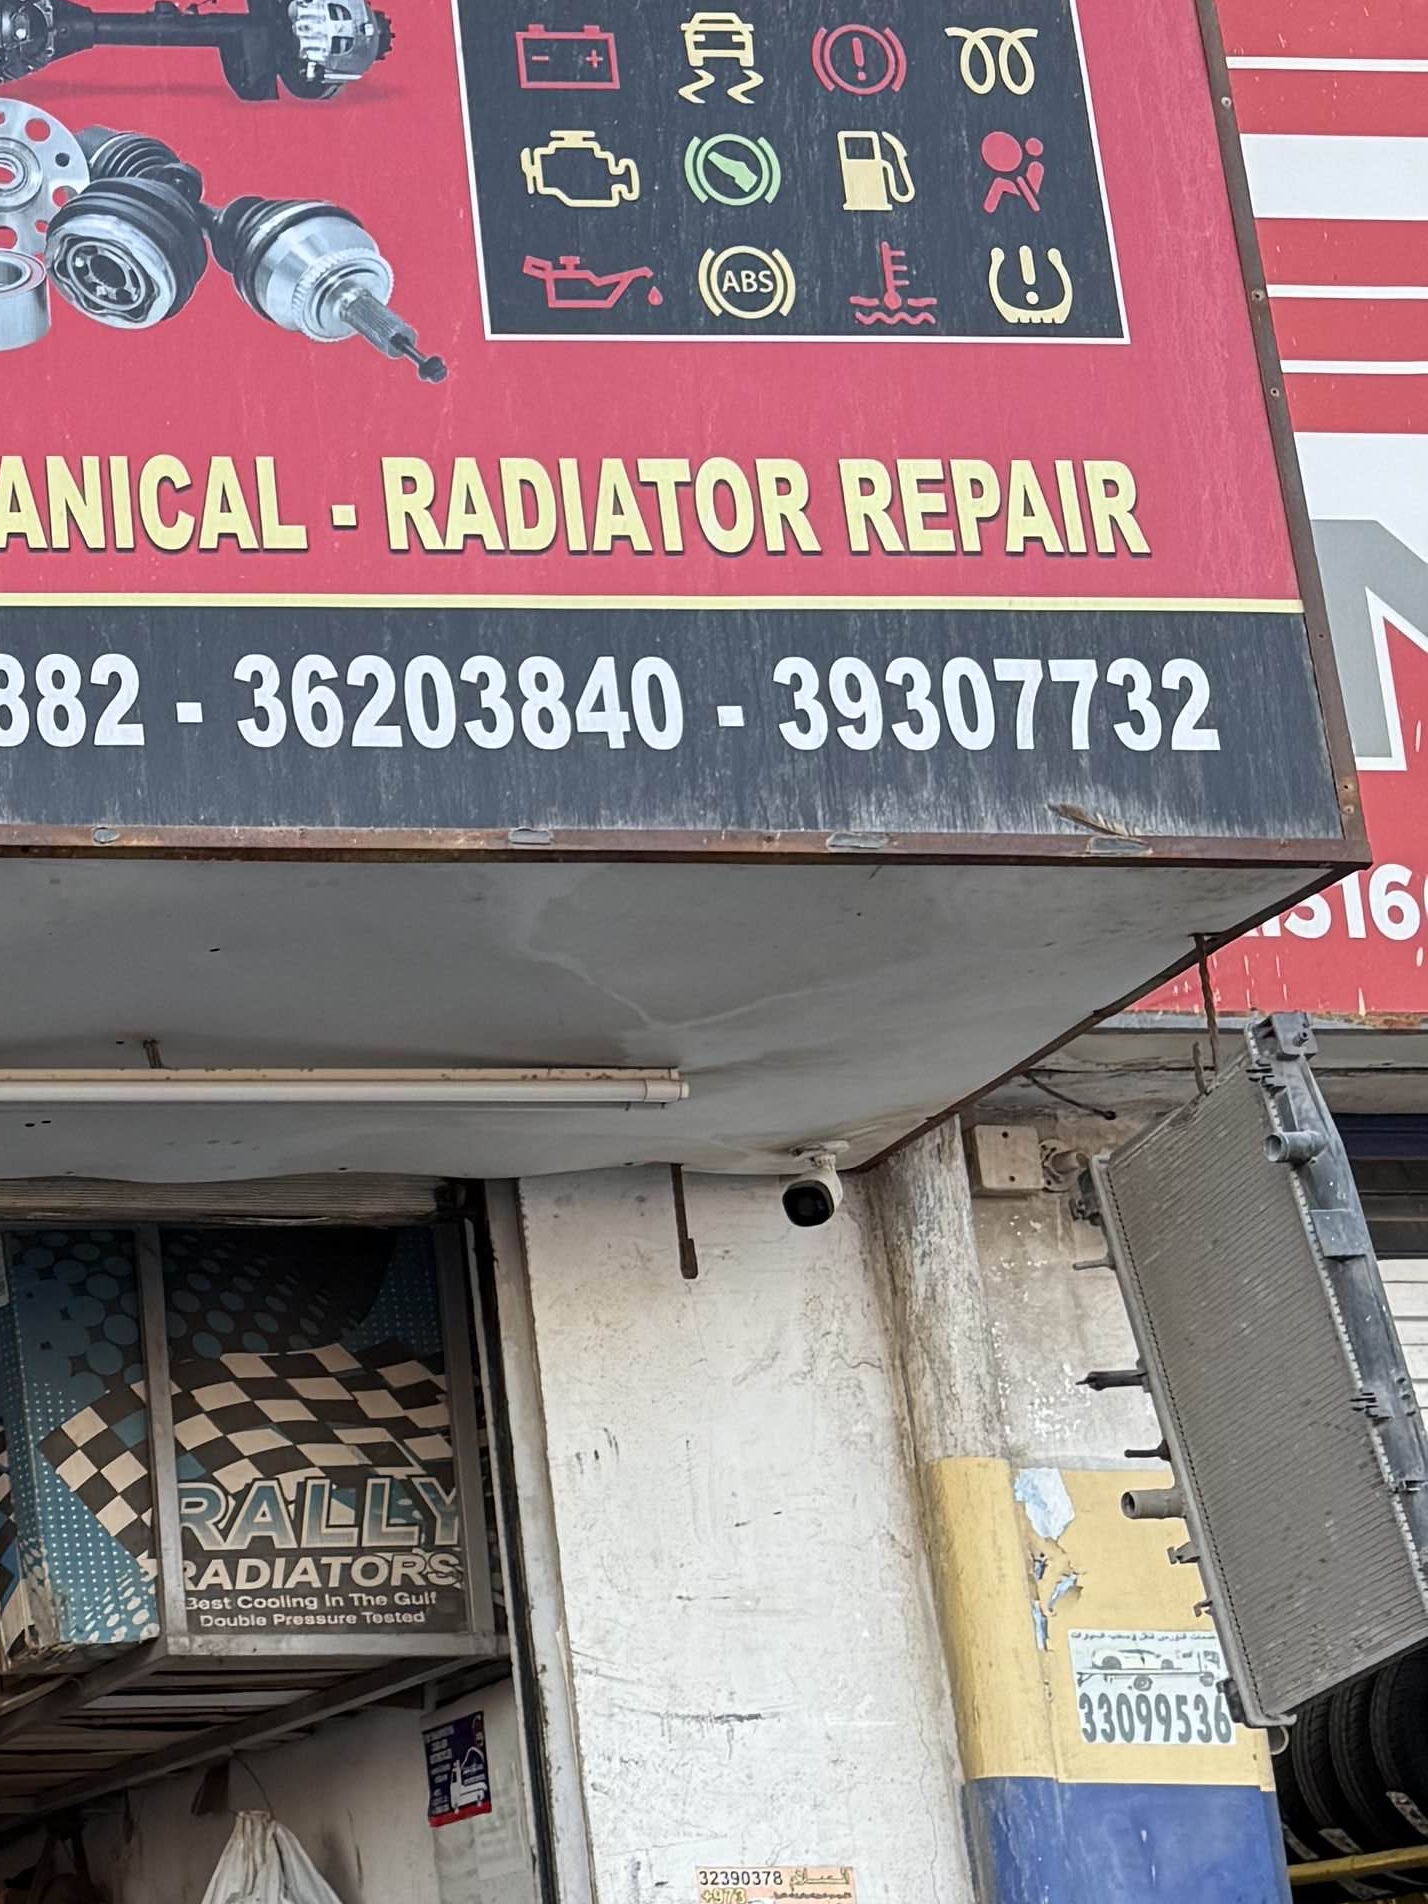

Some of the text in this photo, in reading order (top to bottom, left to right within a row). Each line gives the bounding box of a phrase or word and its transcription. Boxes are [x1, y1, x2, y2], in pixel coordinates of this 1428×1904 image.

[721, 267, 776, 296] ABS
[332, 504, 359, 530] -
[385, 454, 812, 559] RADIATOR
[840, 457, 1152, 560] REPAIR
[177, 701, 205, 726] -
[236, 653, 687, 754] 36203840
[716, 703, 746, 730] -
[775, 655, 1222, 756] 39307732
[178, 1477, 460, 1551] RALLY
[200, 1610, 426, 1627] Double Pressure Tested
[236, 1594, 318, 1610] Cooling
[324, 1593, 345, 1607] In
[348, 1592, 388, 1607] The
[394, 1591, 437, 1606] Gulf
[1078, 1692, 1232, 1744] 33099536
[698, 1870, 784, 1886] 32390378
